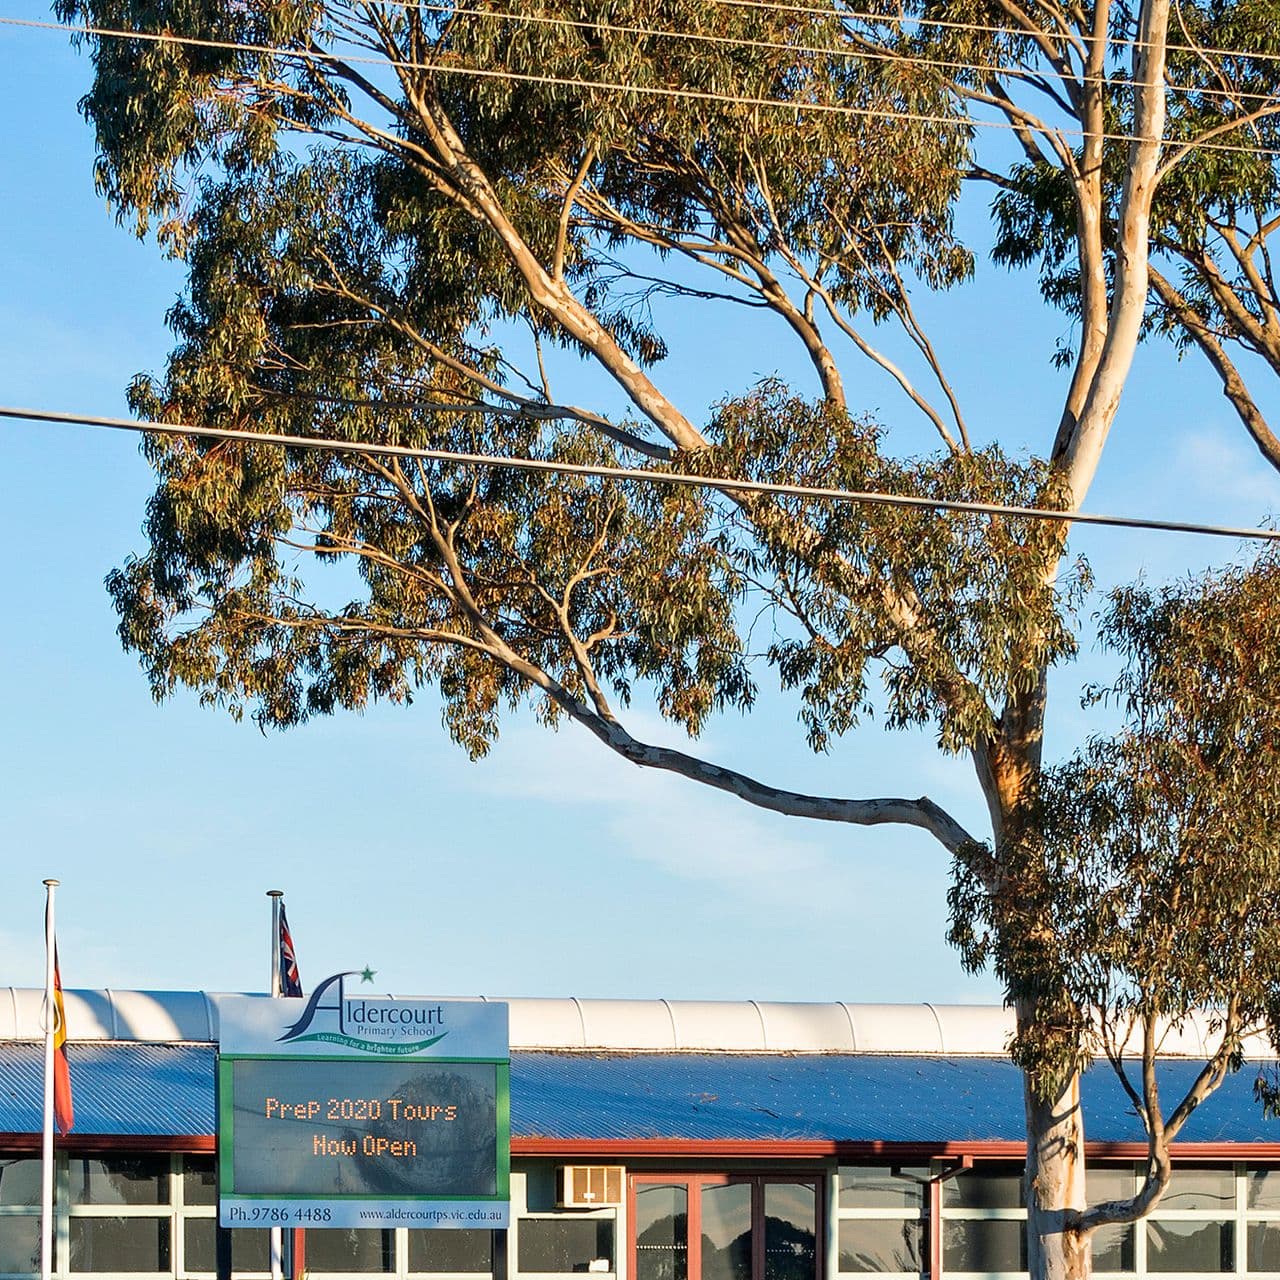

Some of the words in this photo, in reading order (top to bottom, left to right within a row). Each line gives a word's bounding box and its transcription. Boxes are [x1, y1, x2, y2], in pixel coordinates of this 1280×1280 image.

[275, 970, 445, 1042] Aldercourt
[357, 1025, 397, 1039] Primary
[400, 1025, 436, 1037] School
[316, 1033, 349, 1046] Learning
[349, 1040, 360, 1049] for
[366, 1043, 396, 1054] brighter
[327, 1098, 381, 1120] 2020
[387, 1099, 457, 1121] Tours
[313, 1134, 357, 1156] Now
[293, 1207, 332, 1222] 4488
[359, 1208, 502, 1223] www.aldercourtps.vic.edu.au
